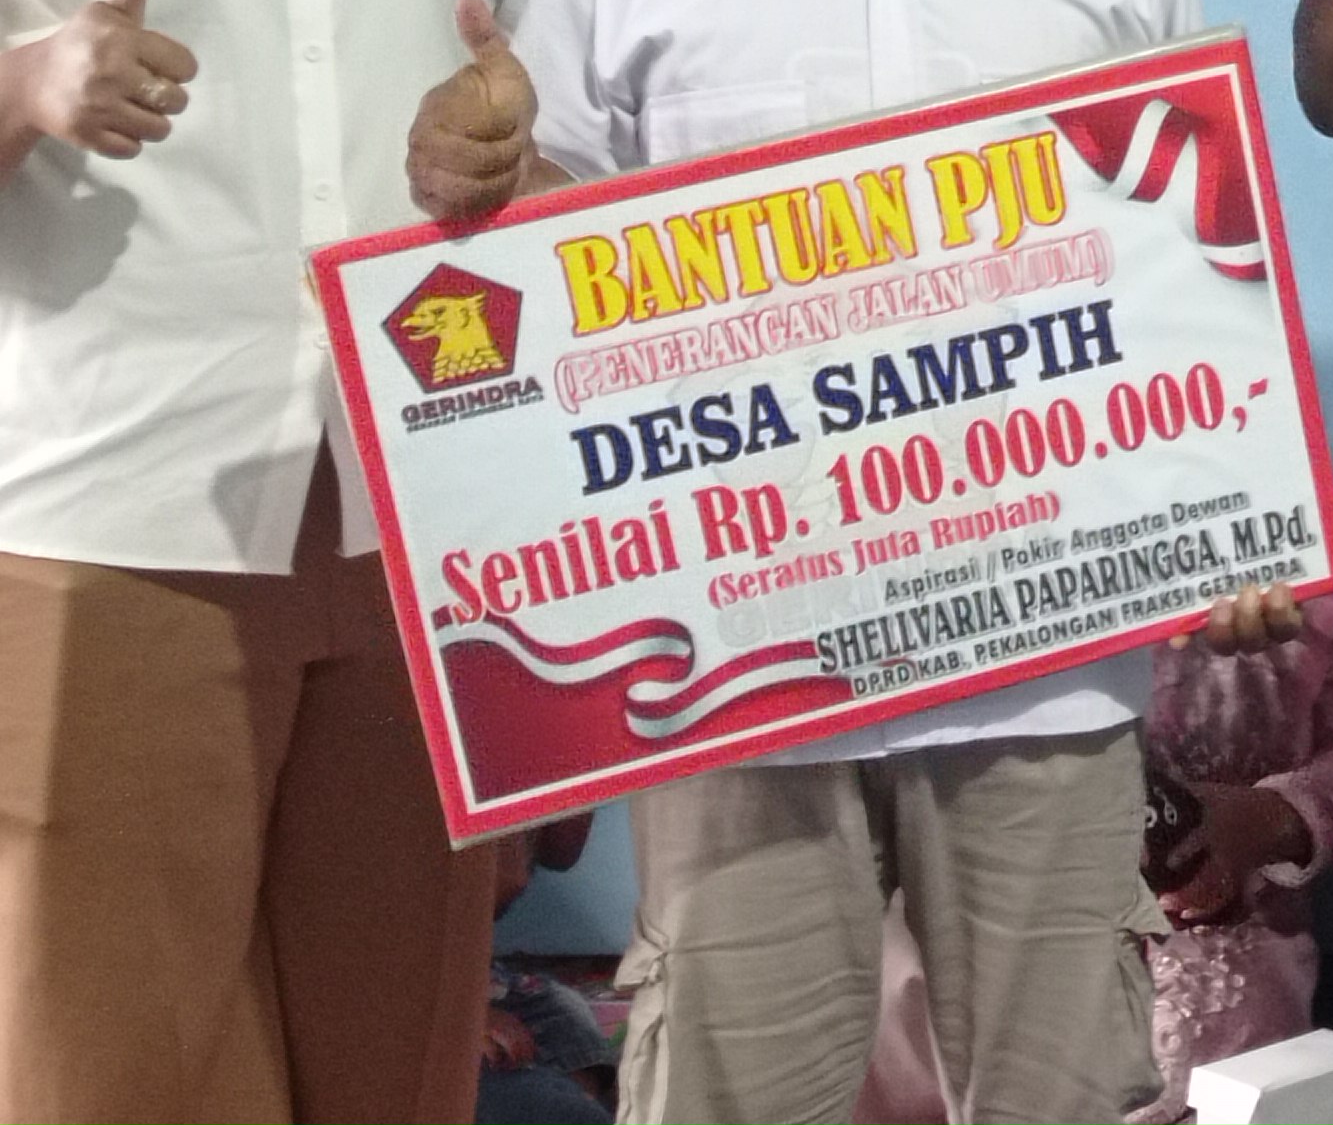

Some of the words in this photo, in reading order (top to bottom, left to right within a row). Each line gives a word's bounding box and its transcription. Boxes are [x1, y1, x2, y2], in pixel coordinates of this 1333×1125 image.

[554, 165, 917, 337] BANTUAN
[926, 130, 1067, 250] PJU
[554, 294, 840, 415] (PENERANGAN
[847, 260, 970, 333] JALAN
[966, 228, 1114, 303] UMUM)
[400, 376, 543, 424] GERINDRA
[570, 383, 799, 496] DESA
[813, 299, 1123, 435] SAMPIH
[441, 499, 680, 627] Senilai
[692, 480, 812, 561] Rp.
[707, 552, 843, 610] (Seratus
[932, 490, 1061, 555] Rupiah)
[884, 556, 979, 604] Aspirasi
[1069, 510, 1166, 553] Anggota
[1170, 490, 1250, 527] Dewan
[1014, 529, 1229, 621] PAPARINGGA,
[1230, 504, 1317, 565] M.Pd.
[853, 666, 910, 697] DPRD
[917, 651, 970, 679] KAB.
[974, 605, 1114, 665] PEKALONGAN
[1121, 585, 1194, 621] FRAKSI
